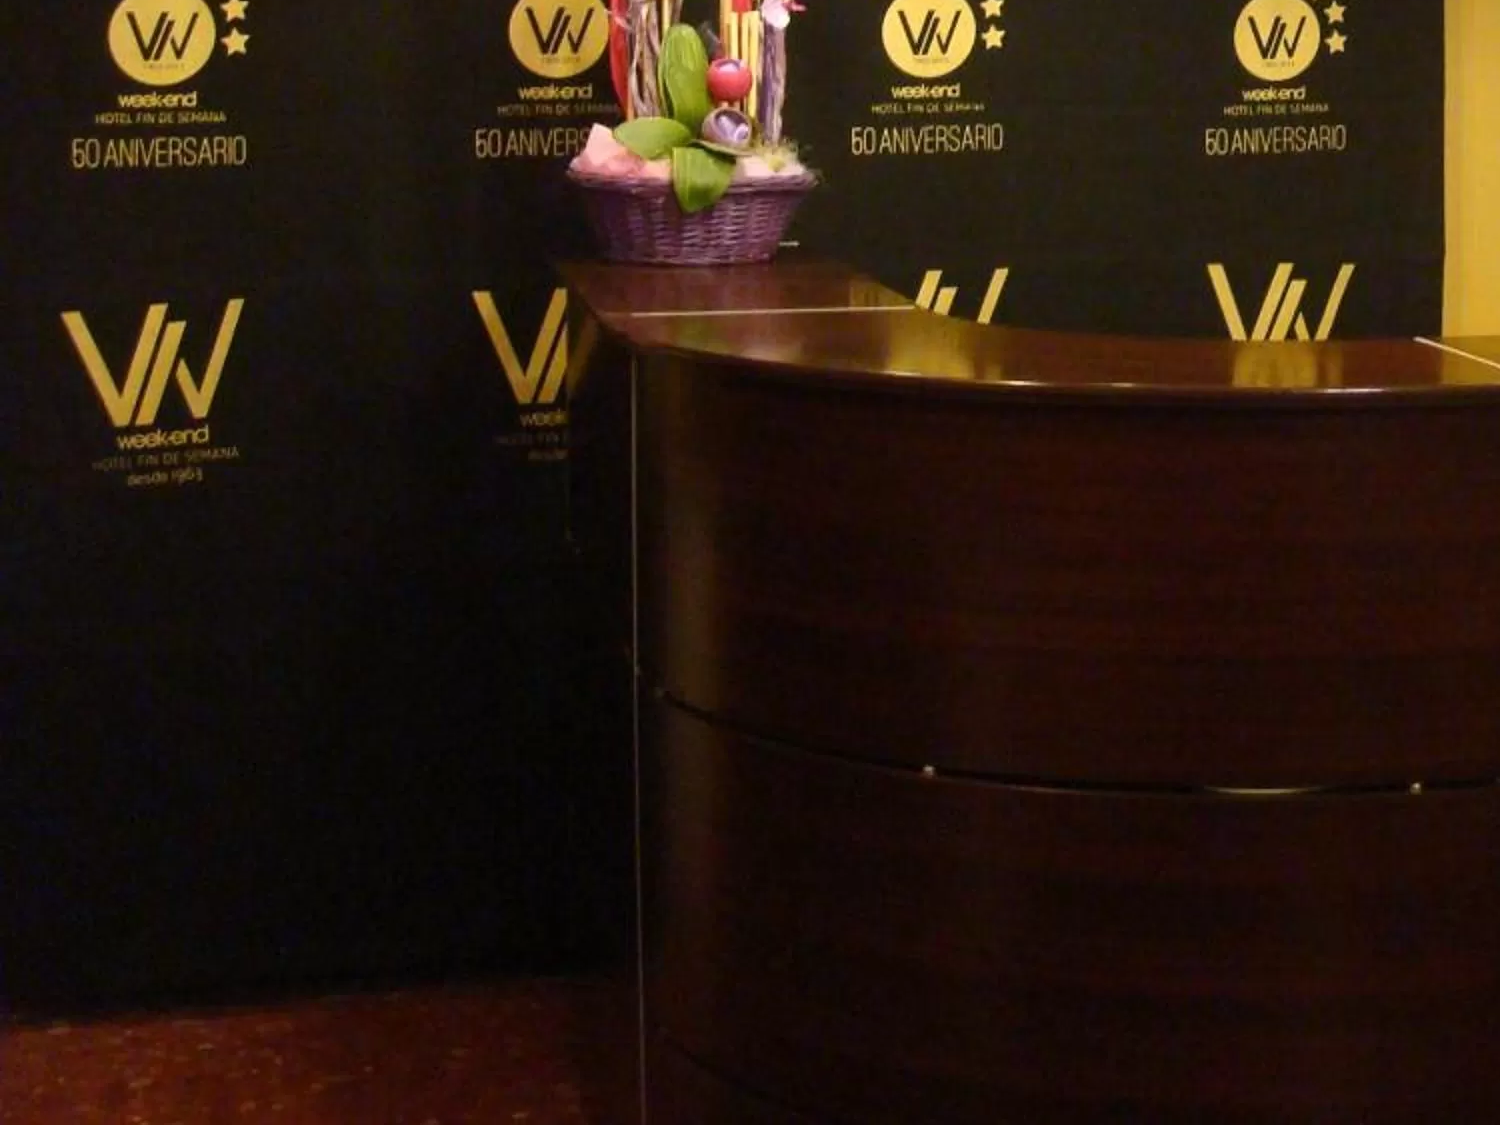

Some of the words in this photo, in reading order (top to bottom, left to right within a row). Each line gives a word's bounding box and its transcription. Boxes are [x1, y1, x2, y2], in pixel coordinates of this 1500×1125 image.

[103, 135, 247, 168] ANIVERSARIO
[879, 124, 1004, 155] ANIVERSARIO
[1231, 125, 1347, 155] ANIVERSARIO
